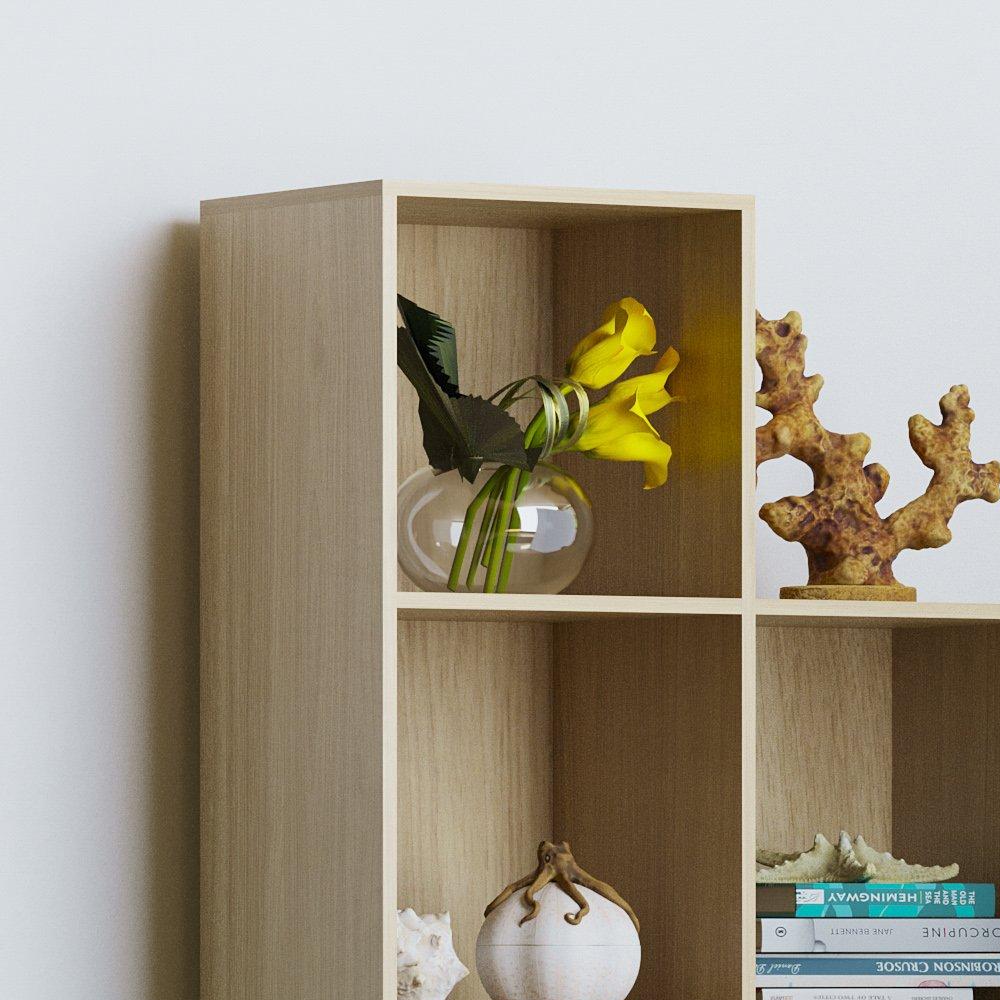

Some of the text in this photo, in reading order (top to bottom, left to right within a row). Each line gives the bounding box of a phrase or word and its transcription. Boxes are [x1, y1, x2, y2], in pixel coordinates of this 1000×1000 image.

[828, 892, 917, 903] HEMINGWAY
[924, 891, 933, 904] SEA
[933, 890, 941, 905] THE
[942, 890, 950, 906] AND
[950, 889, 958, 906] MAN
[959, 890, 967, 905] OLD
[968, 891, 976, 905] THE
[830, 928, 894, 936] JANE BENNETT
[766, 963, 802, 975] Daniel
[876, 961, 1000, 973] ROBINSON CRUSOE
